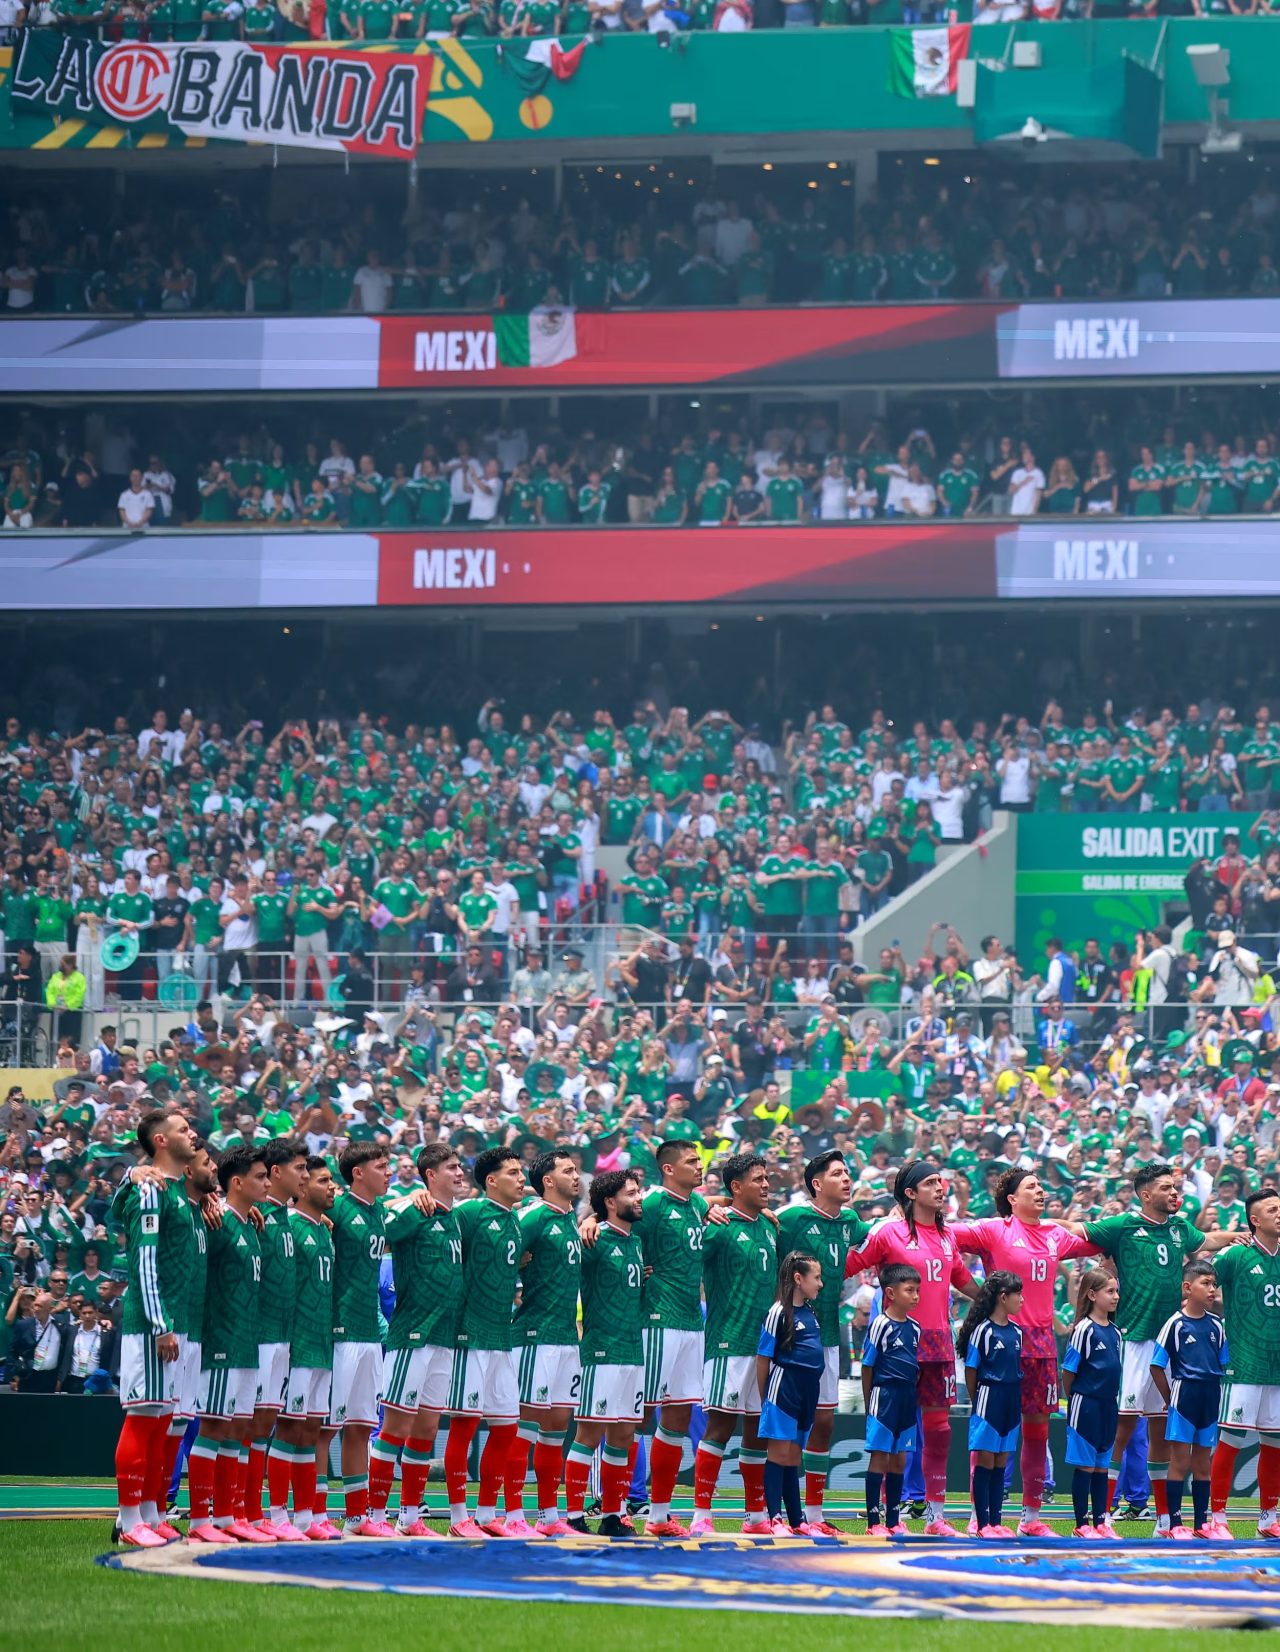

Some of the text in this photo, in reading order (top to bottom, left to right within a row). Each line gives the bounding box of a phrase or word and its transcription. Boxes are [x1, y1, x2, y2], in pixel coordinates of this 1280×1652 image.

[11, 28, 94, 112] LA
[167, 46, 418, 150] BANDA
[1081, 826, 1220, 858] SALIDA EXIT
[1082, 874, 1122, 891] SALIDA
[1123, 874, 1138, 891] DE
[282, 1232, 294, 1257] 18
[369, 1234, 386, 1260] 20
[687, 1227, 703, 1250] 22
[507, 1240, 516, 1265] 2
[759, 1247, 768, 1272] 7
[829, 1243, 839, 1267] 4
[1156, 1243, 1169, 1266] 9
[318, 1256, 331, 1282] 17
[627, 1263, 641, 1287] 21
[925, 1258, 943, 1282] 12
[1030, 1258, 1047, 1282] 13
[944, 1374, 956, 1399] 12
